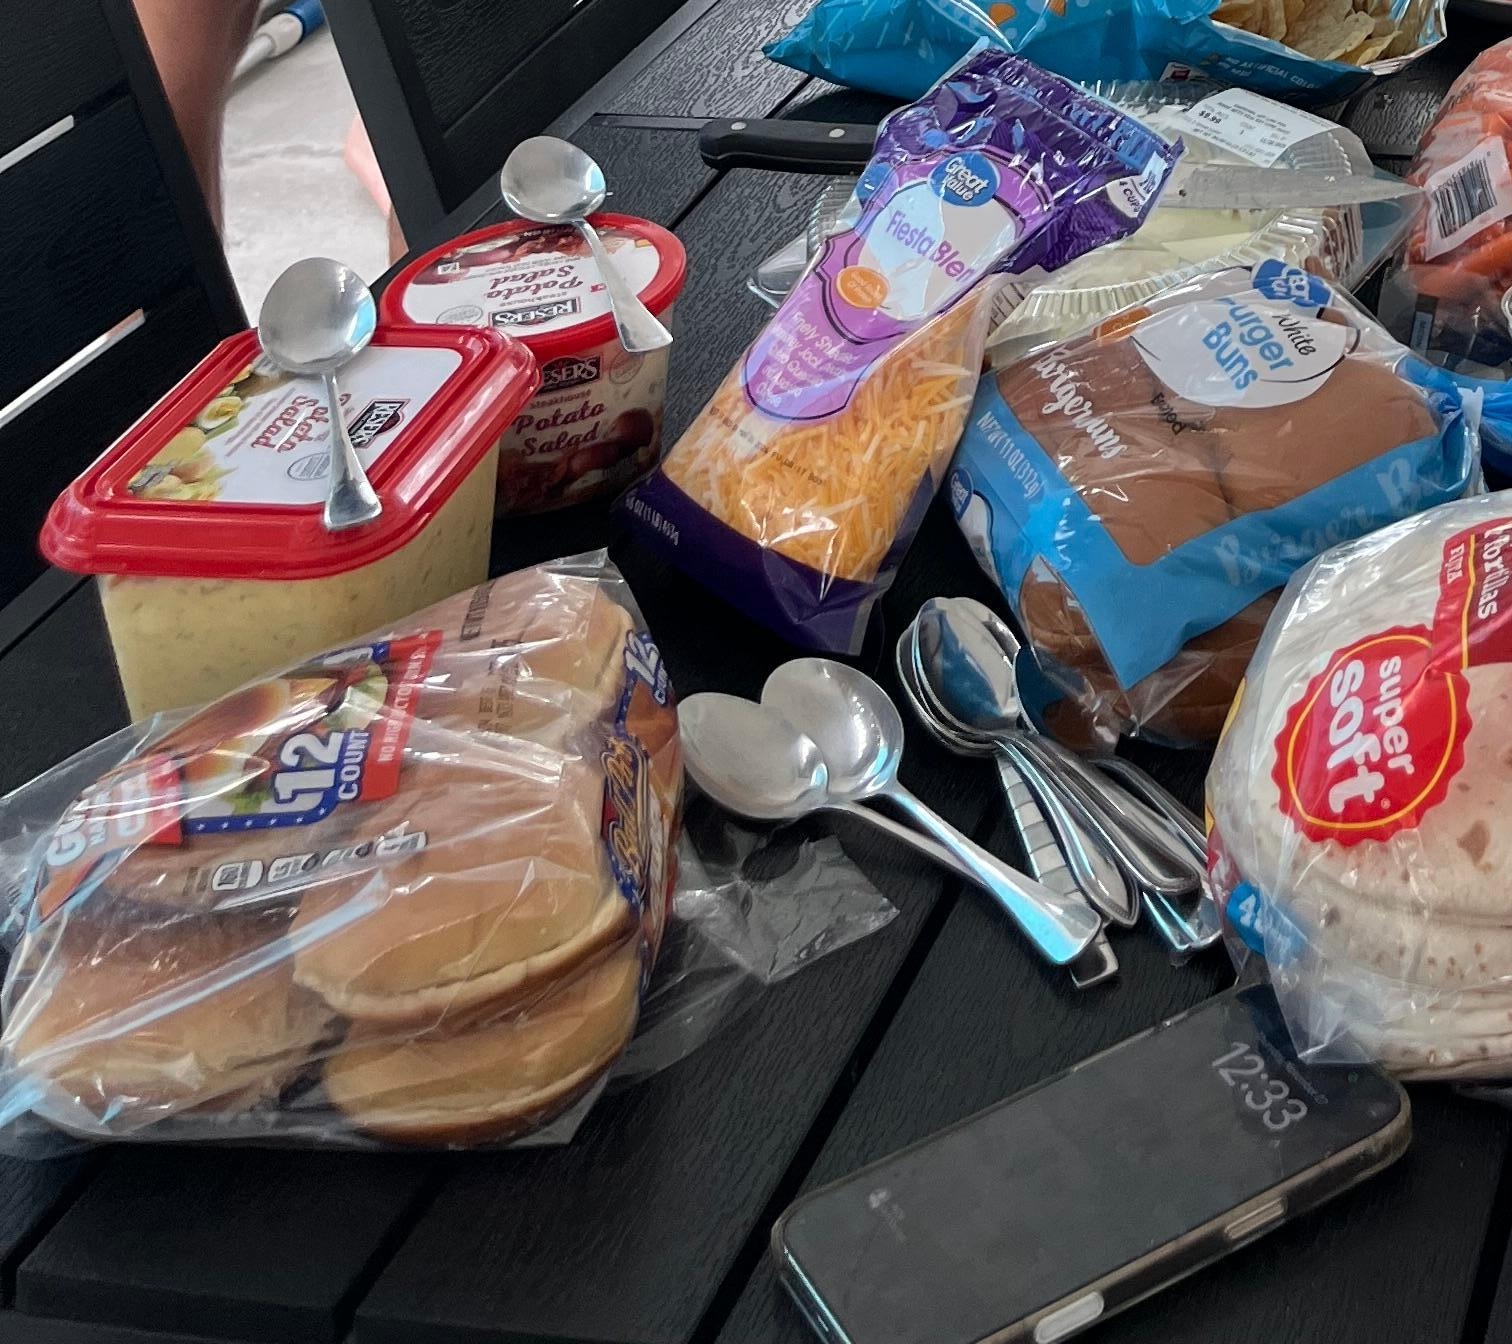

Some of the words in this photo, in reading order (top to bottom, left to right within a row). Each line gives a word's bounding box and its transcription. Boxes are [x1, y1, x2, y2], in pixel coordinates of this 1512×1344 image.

[943, 156, 990, 194] Great
[885, 211, 932, 257] Fiesta
[930, 240, 976, 283] Blen
[486, 276, 584, 300] Potato
[489, 264, 575, 289] Salad
[1201, 321, 1259, 391] Buns
[1272, 311, 1316, 357] White
[251, 394, 320, 450] Salad
[514, 403, 607, 434] Potato
[520, 422, 602, 456] Salad
[1327, 658, 1387, 813] soft
[1371, 654, 1415, 776] super
[274, 730, 346, 805] 12
[337, 728, 368, 802] COUNT
[378, 744, 396, 762] NO
[1212, 1041, 1308, 1130] 12:33
